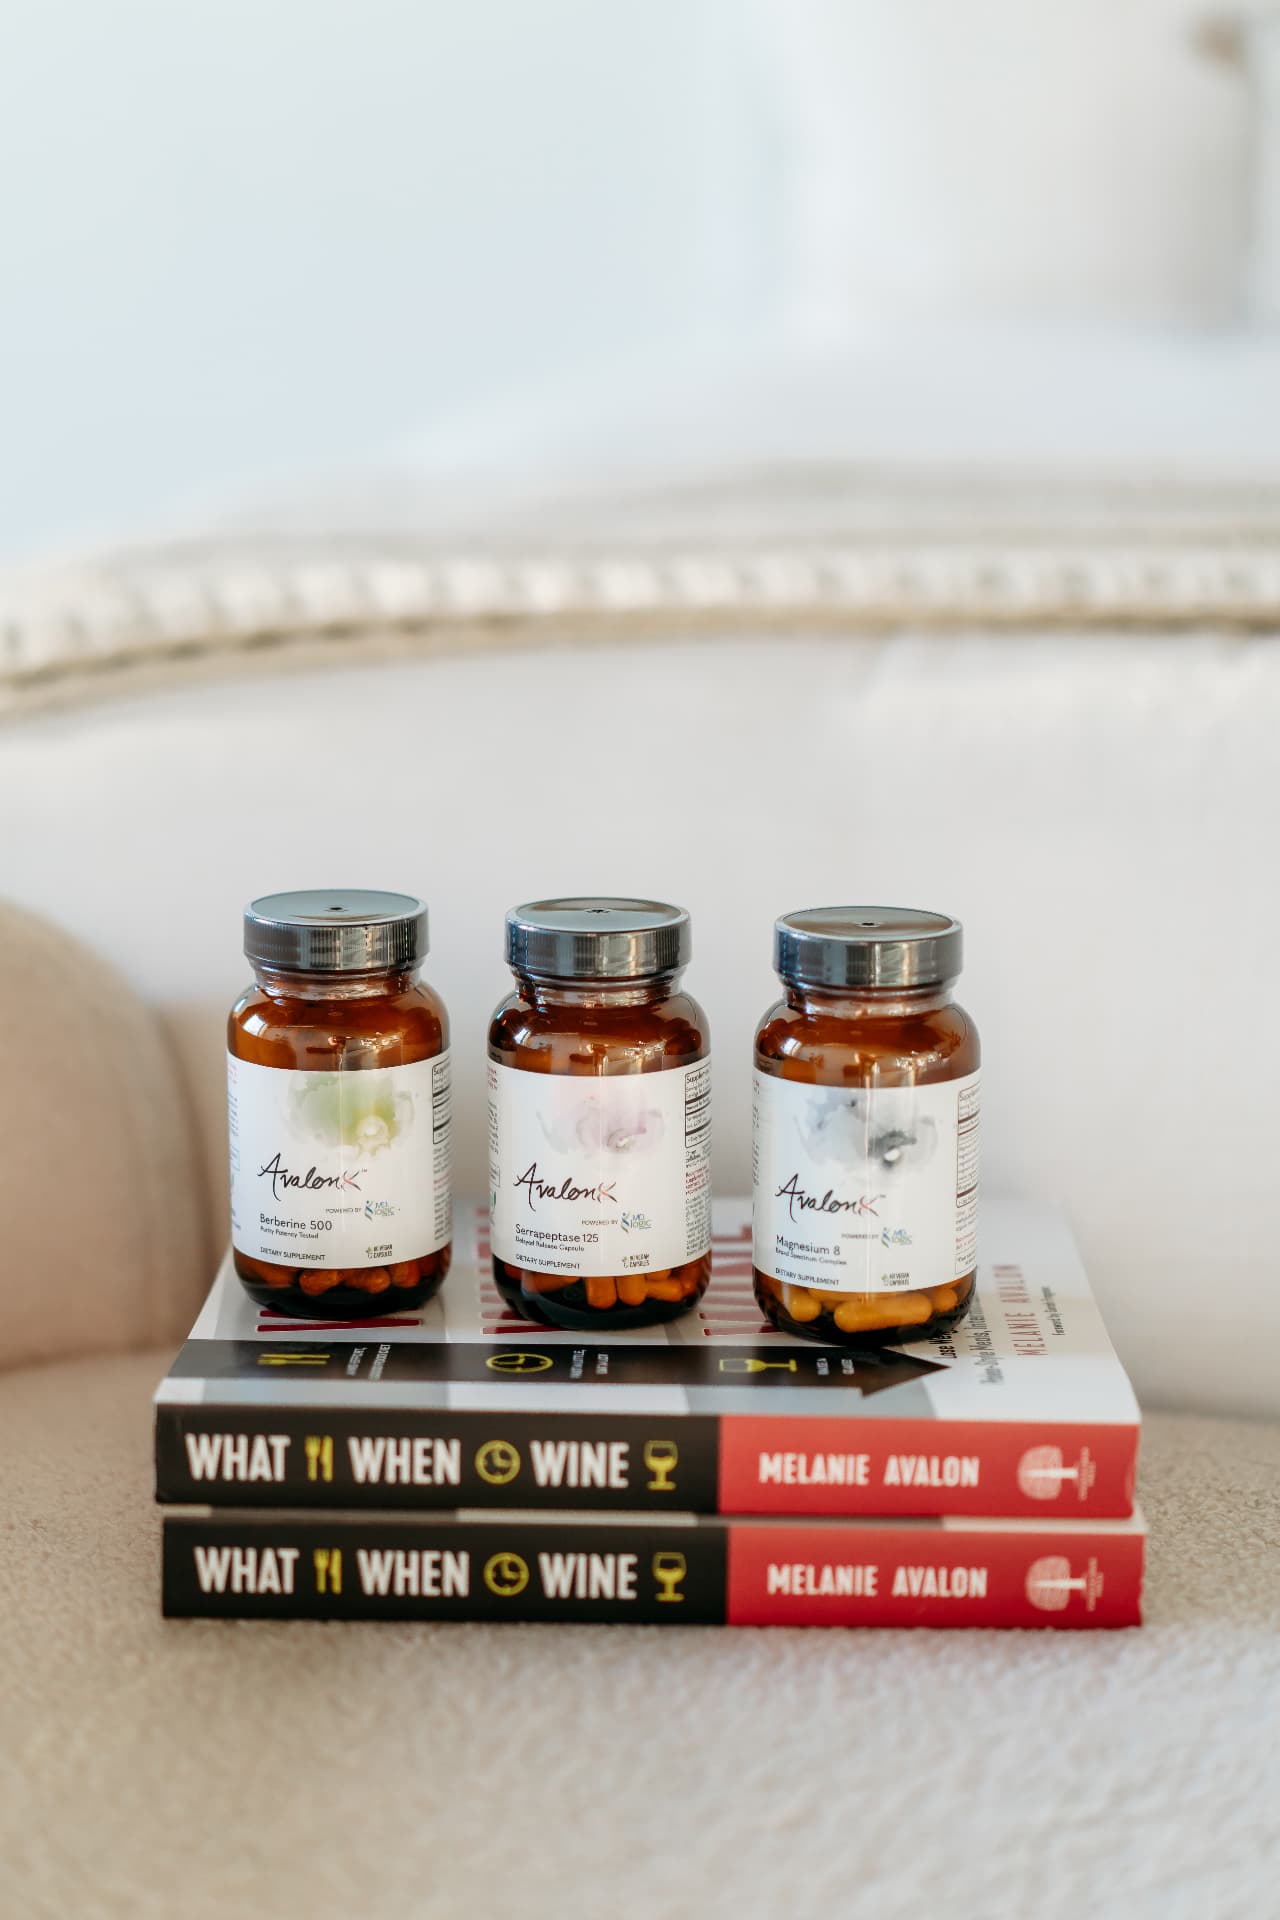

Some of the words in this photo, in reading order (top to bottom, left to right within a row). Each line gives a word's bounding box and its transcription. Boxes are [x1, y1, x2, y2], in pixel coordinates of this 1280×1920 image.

[260, 1213, 306, 1230] Berberine
[310, 1220, 333, 1231] 500
[515, 1223, 580, 1243] Serrapeptase
[582, 1233, 599, 1243] 125
[260, 1246, 282, 1257] DIETARY
[283, 1251, 326, 1261] SUPPLEMENT
[560, 1244, 584, 1252] Capsule
[776, 1234, 830, 1254] Magnesium
[833, 1245, 841, 1256] 8
[515, 1254, 538, 1264] DIETARY
[538, 1259, 580, 1269] SUPPLEMENT
[775, 1267, 797, 1279] DIETARY
[797, 1273, 840, 1286] SUPPLEMENT
[966, 1330, 996, 1351] Meals,
[1003, 1312, 1048, 1356] MELANIE
[932, 1345, 958, 1359] Lose
[185, 1433, 291, 1482] WHAT
[347, 1436, 461, 1485] WHEN
[530, 1440, 630, 1489] WINE
[759, 1452, 870, 1486] MELANIE
[883, 1454, 980, 1488] AVALON
[194, 1546, 300, 1595] WHAT
[356, 1549, 470, 1597] WHEN
[538, 1552, 638, 1600] WINE
[767, 1563, 879, 1597] MELANIE
[891, 1565, 988, 1599] AVALON
